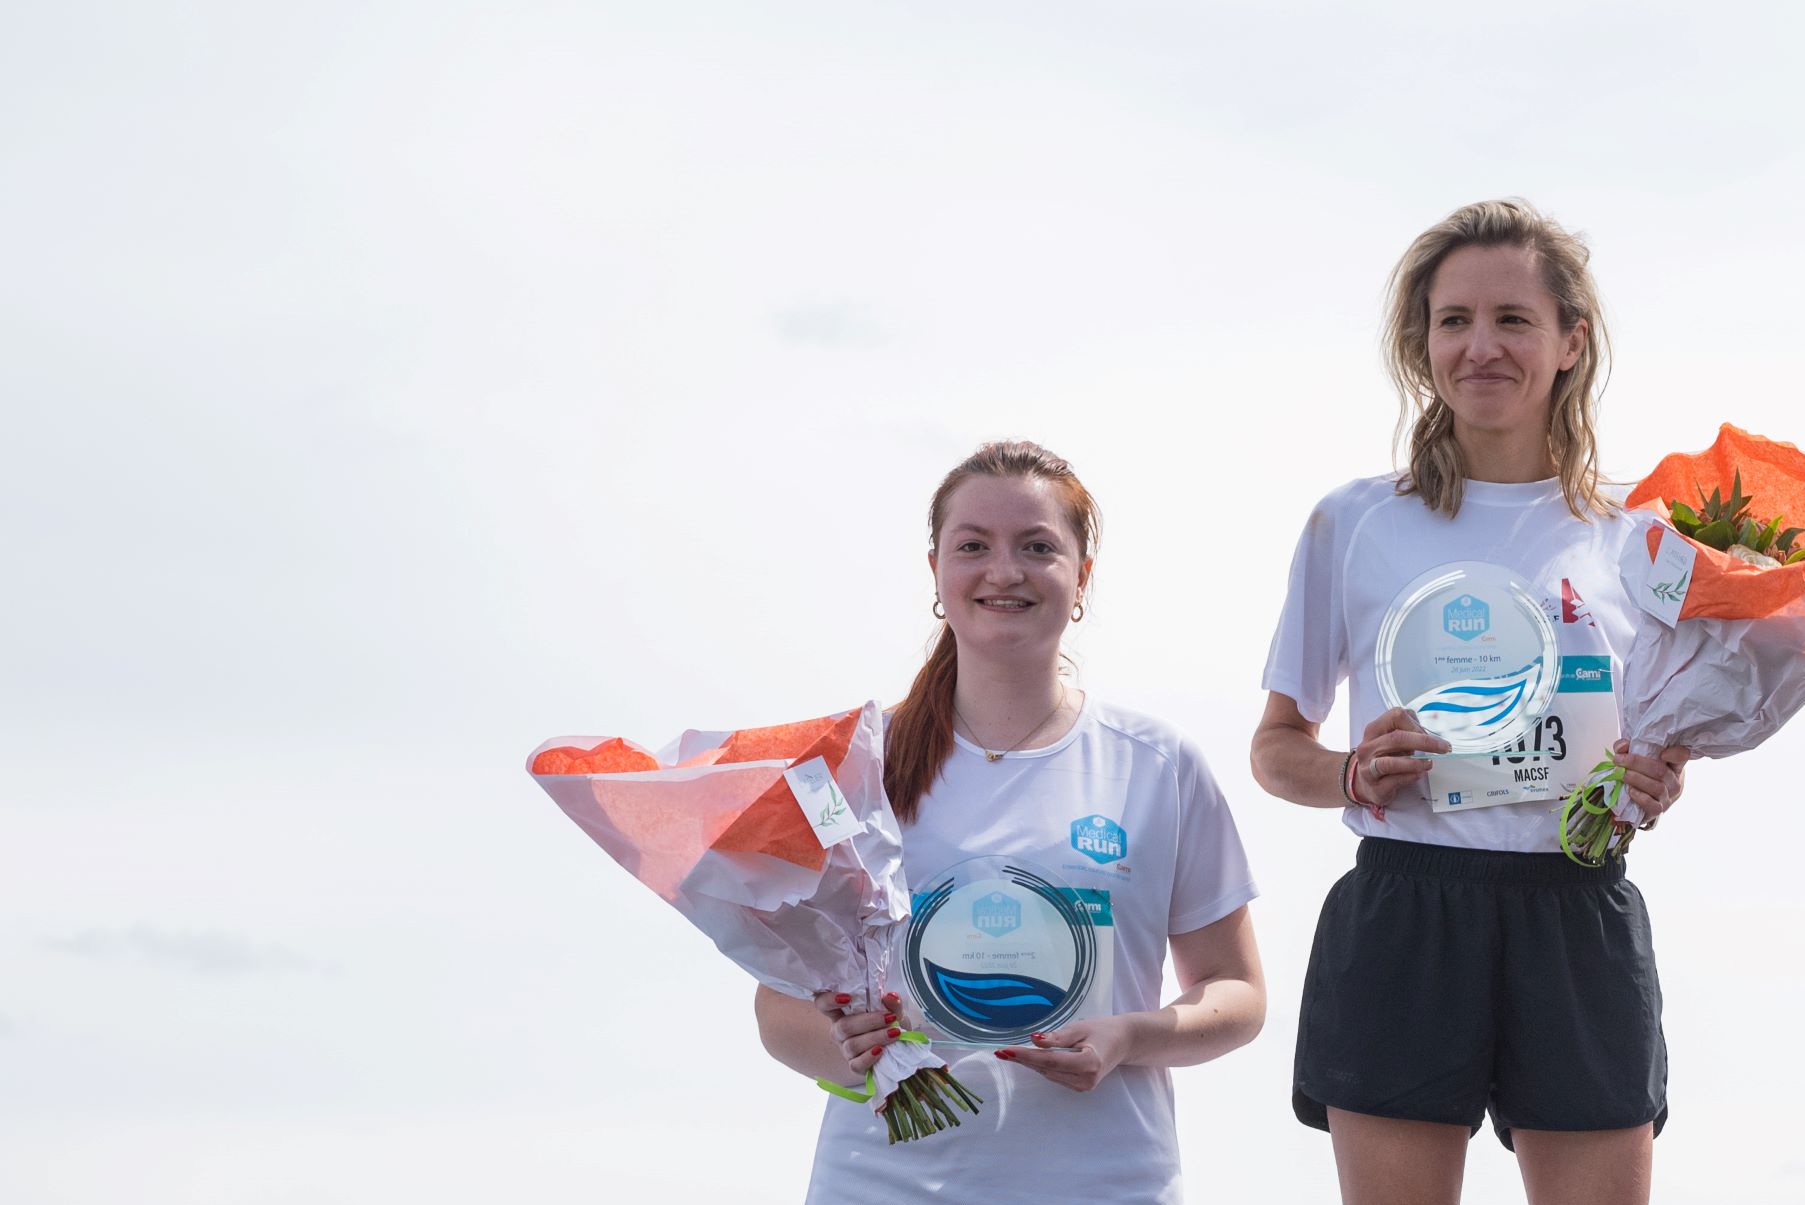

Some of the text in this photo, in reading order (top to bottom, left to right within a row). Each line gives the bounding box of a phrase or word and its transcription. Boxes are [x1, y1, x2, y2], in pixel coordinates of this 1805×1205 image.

[1448, 618, 1486, 632] Run
[1447, 655, 1473, 664] femme
[1479, 655, 1488, 663] 10
[1489, 654, 1501, 663] km
[1576, 667, 1601, 679] Cami
[1514, 766, 1550, 783] MACSF
[1076, 824, 1122, 843] Medical
[1077, 836, 1122, 857] Run
